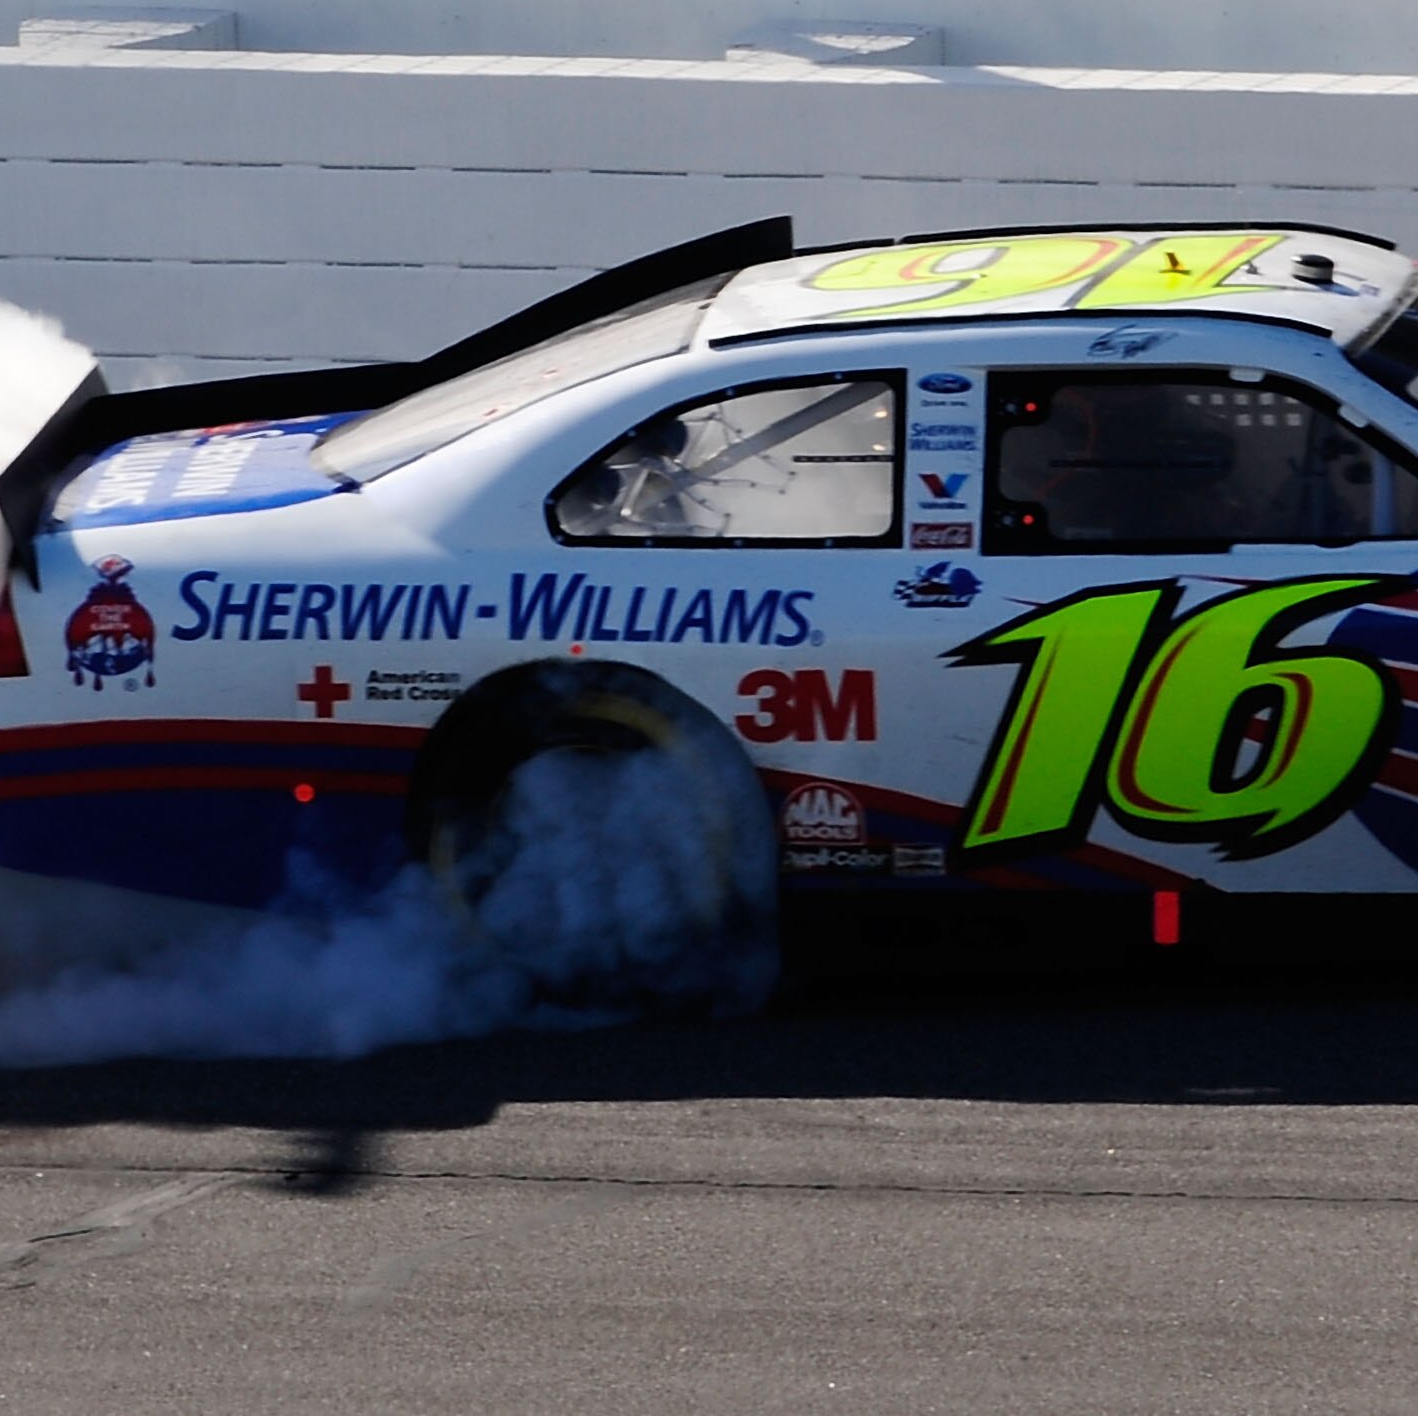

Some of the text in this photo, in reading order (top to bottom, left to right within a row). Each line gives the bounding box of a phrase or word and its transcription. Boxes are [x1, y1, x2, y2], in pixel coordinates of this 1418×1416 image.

[367, 670, 462, 683] American
[367, 687, 404, 700] Red
[735, 668, 877, 744] 3M
[953, 574, 1399, 854] 16
[784, 788, 859, 827] MAC
[786, 826, 859, 839] TOOLS
